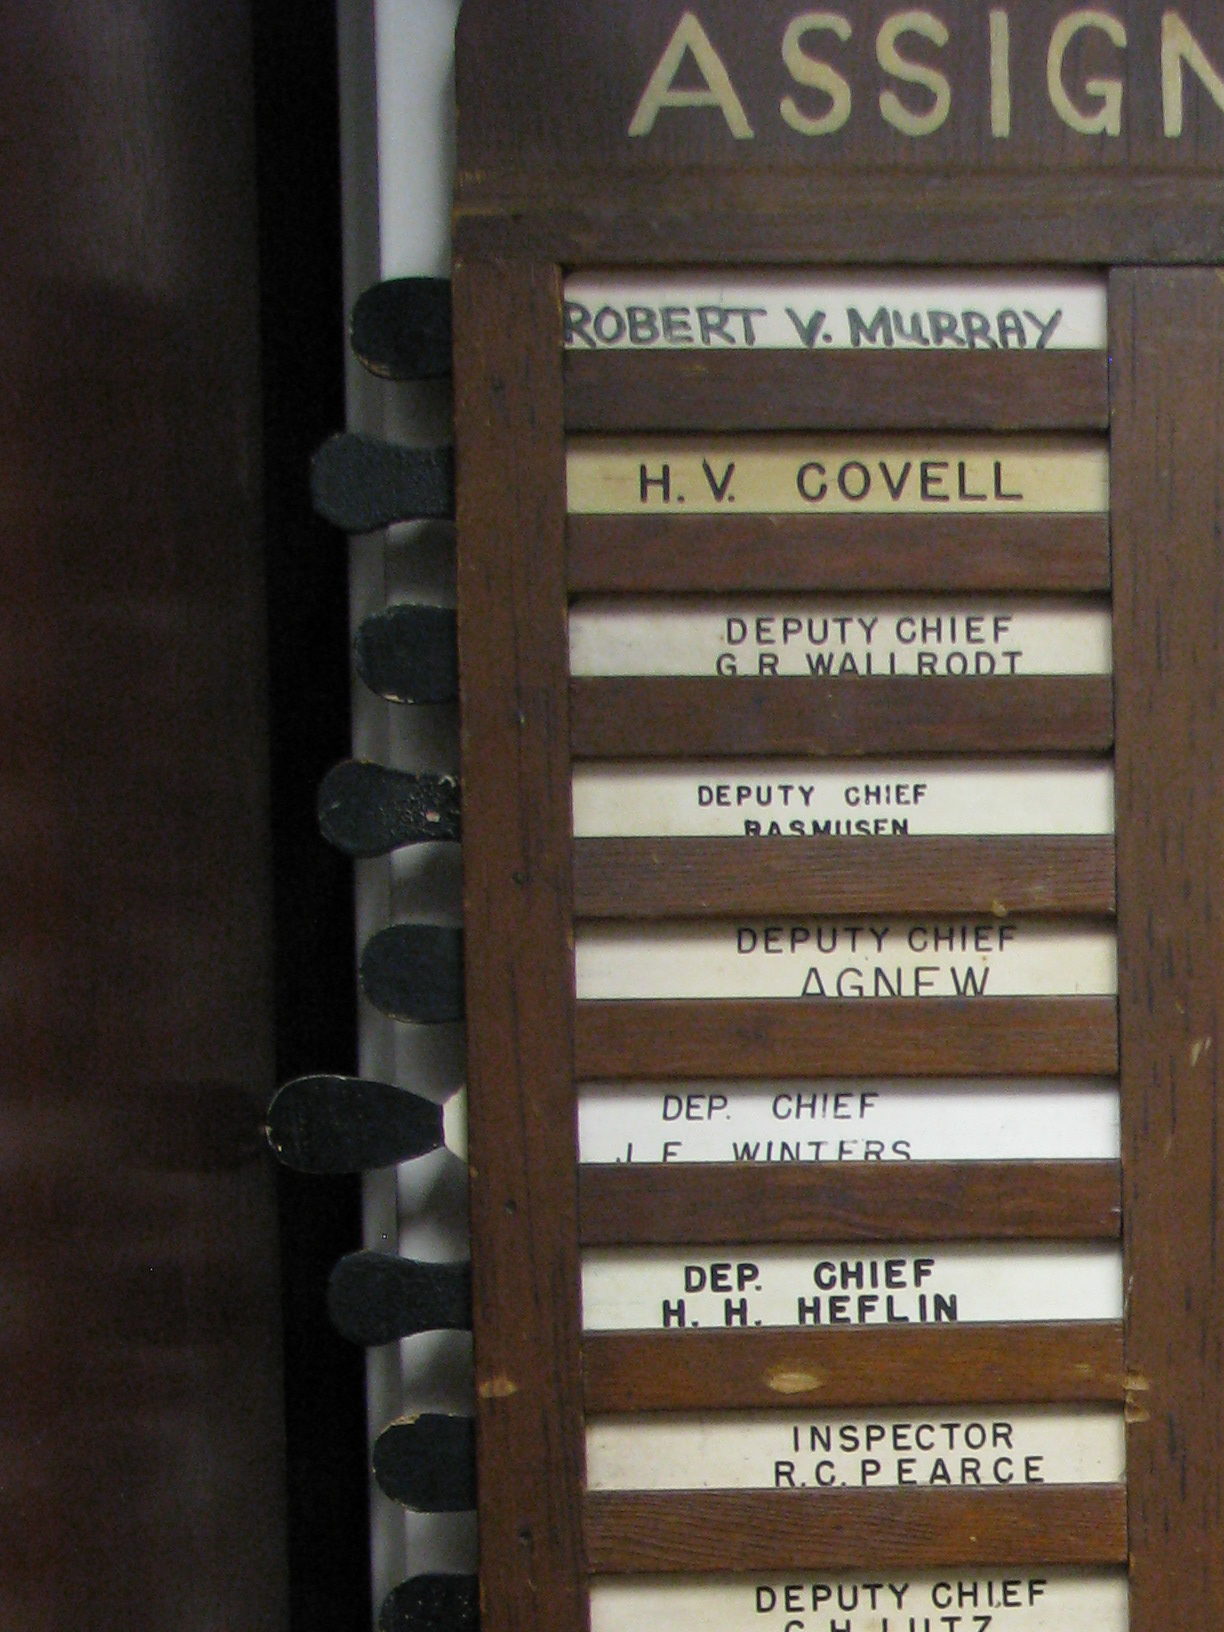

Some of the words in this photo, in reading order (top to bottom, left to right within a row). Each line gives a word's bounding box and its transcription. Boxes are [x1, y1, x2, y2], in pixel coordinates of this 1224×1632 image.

[565, 302, 767, 348] ROBERT
[785, 307, 832, 347] V.
[796, 461, 1023, 502] COVELL
[726, 617, 880, 645] DEPUTY
[896, 617, 1013, 643] CHIEF
[698, 785, 816, 806] DEPUTY
[844, 784, 929, 804] CHIEF
[736, 927, 891, 954] DEPUTY
[906, 925, 1018, 953] CHIEF
[800, 966, 992, 997] AGNEW
[662, 1094, 733, 1121] DEP.
[771, 1092, 881, 1119] CHIEF
[732, 1139, 914, 1162] WINTERS
[684, 1263, 764, 1293] DEP.
[813, 1259, 937, 1290] CHIEF
[662, 1299, 701, 1328] H.
[724, 1298, 764, 1327] H.
[797, 1293, 958, 1325] HEFLIN
[792, 1422, 1014, 1453] INSPECTOR
[860, 1456, 1045, 1486] PEARCE
[755, 1584, 910, 1614] DEPUTY
[931, 1579, 1048, 1610] CHIEF
